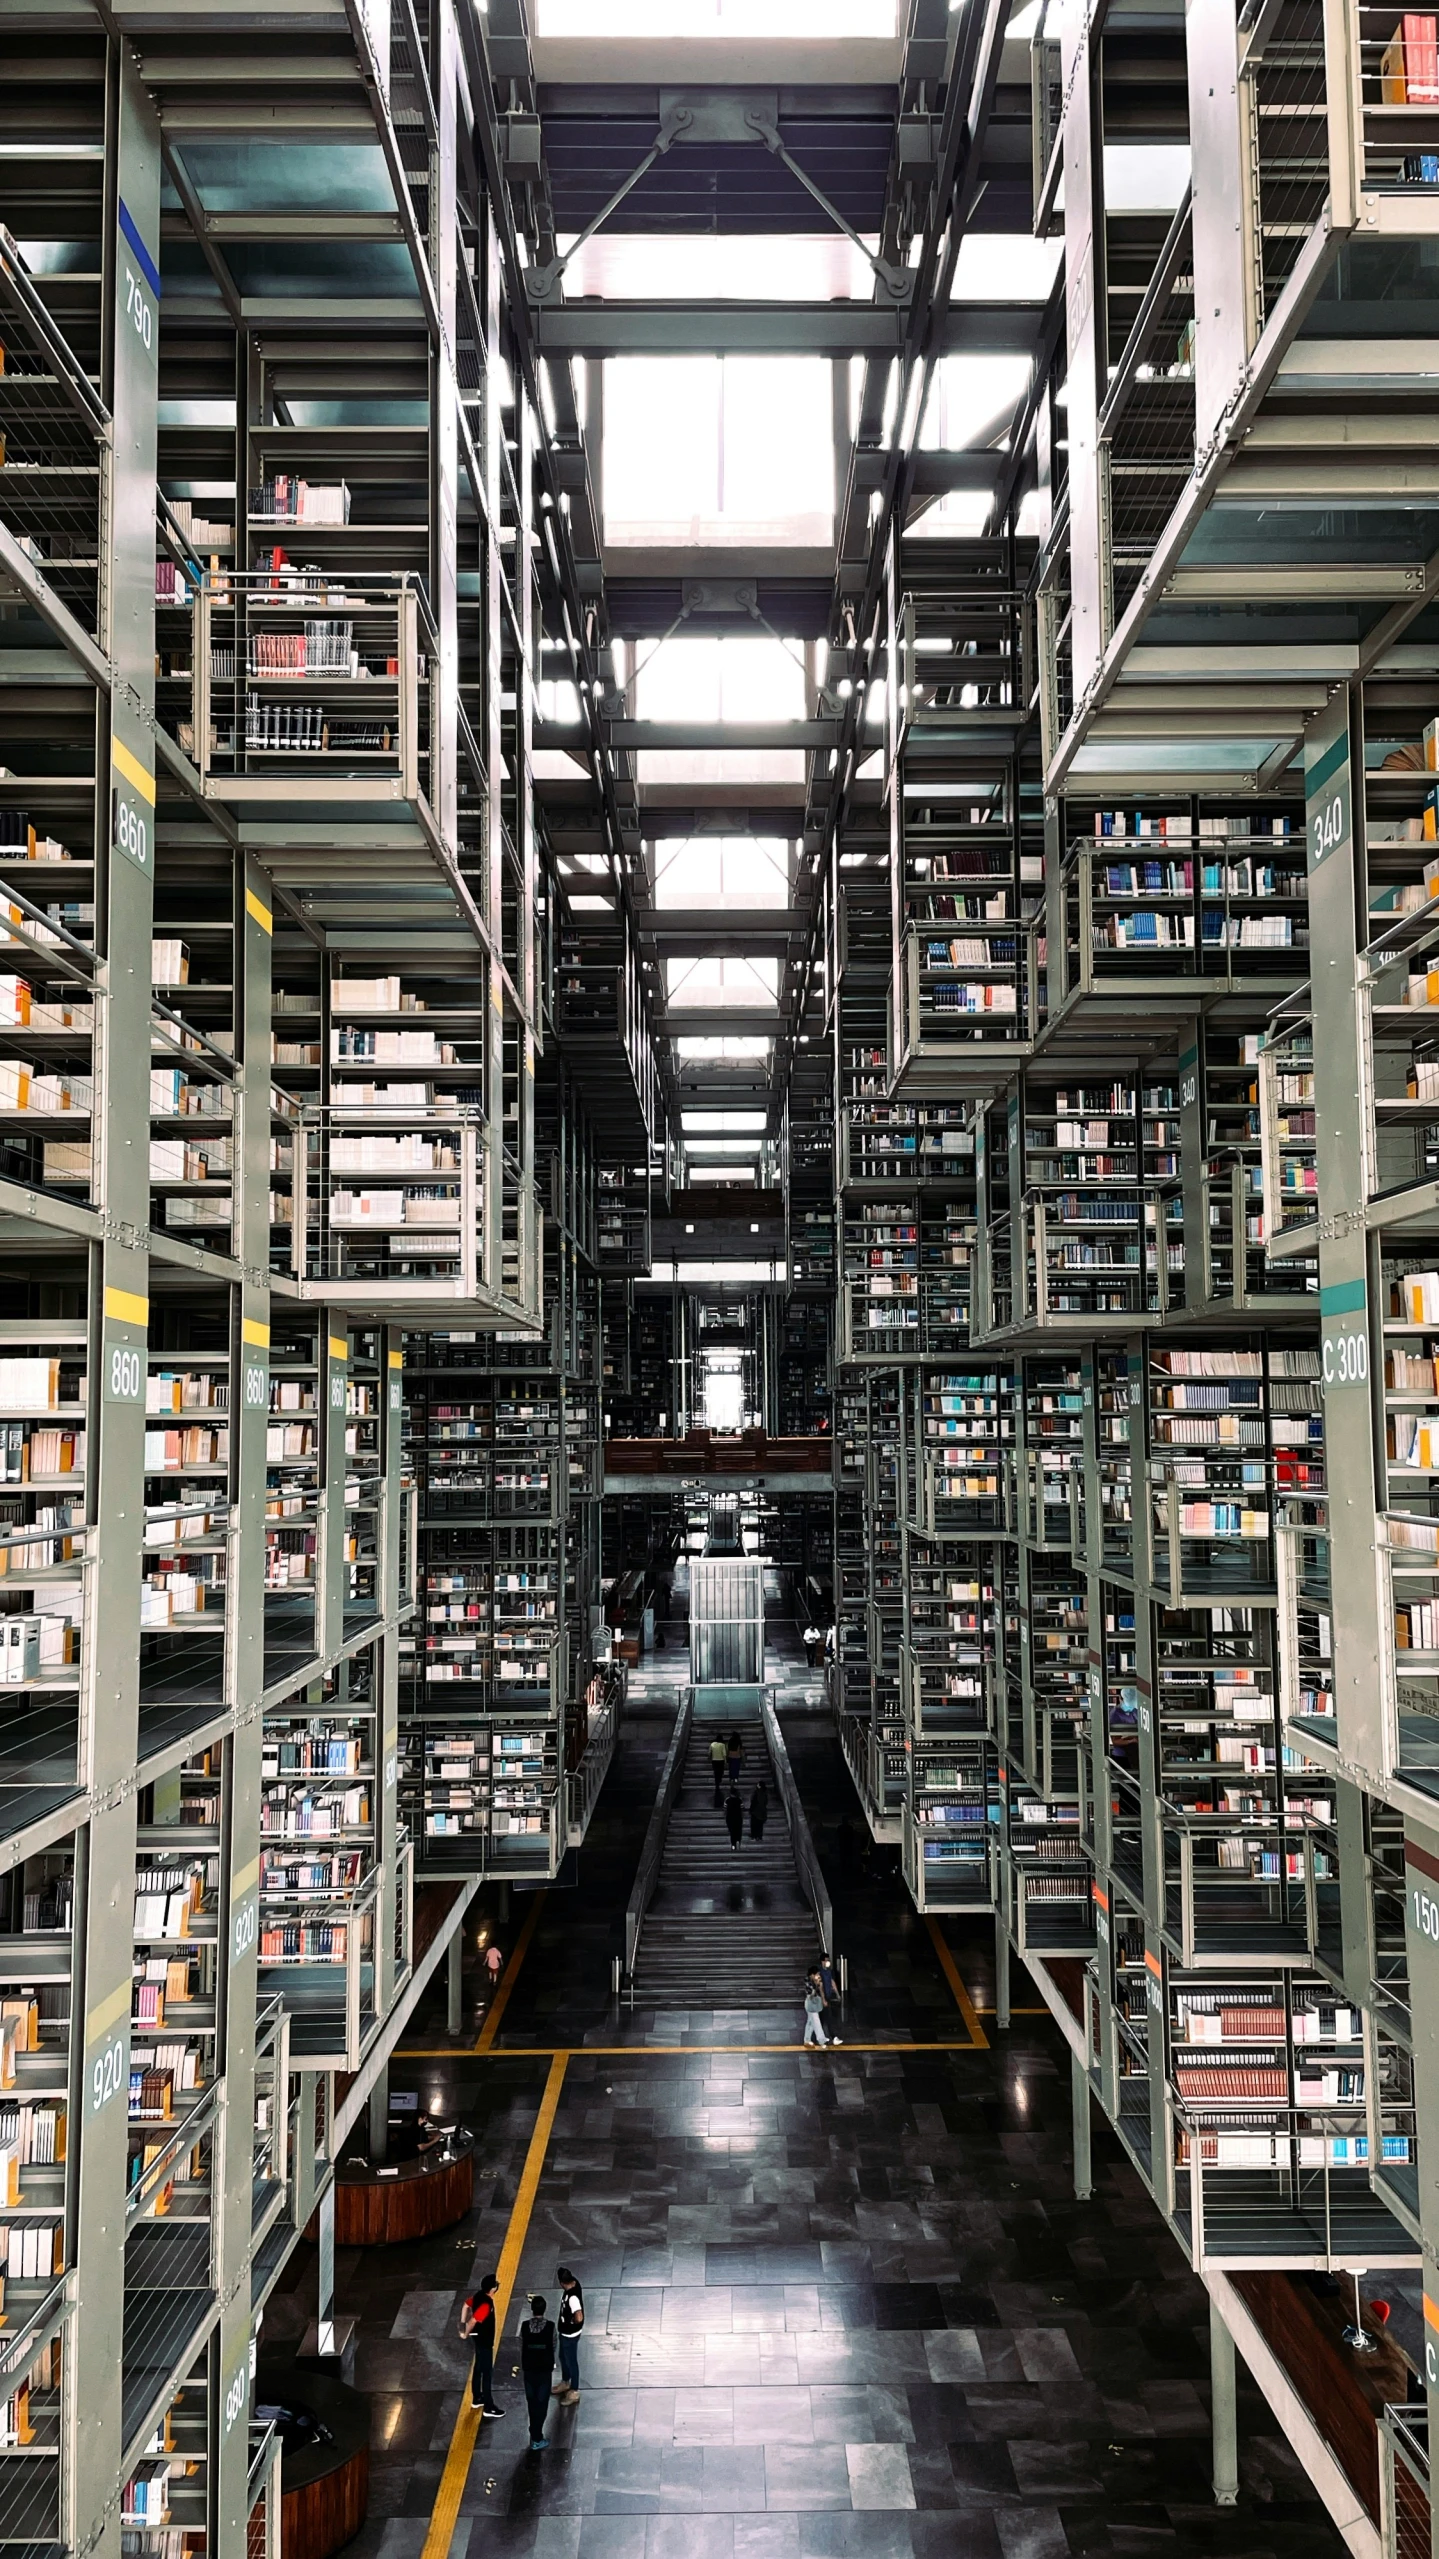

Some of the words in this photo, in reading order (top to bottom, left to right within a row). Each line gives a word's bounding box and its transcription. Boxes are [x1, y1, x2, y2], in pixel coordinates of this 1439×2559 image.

[126, 267, 152, 351] 790
[1070, 272, 1087, 350] 500
[119, 801, 146, 863] 860
[1313, 795, 1343, 861] 340
[1182, 1076, 1195, 1107] 340
[111, 1349, 139, 1398] 860
[1322, 1339, 1335, 1383] C
[1337, 1333, 1367, 1381] 300
[246, 1368, 264, 1404] 860
[331, 1377, 344, 1407] 860
[1130, 1383, 1140, 1405] 300
[1091, 1673, 1100, 1697] 150
[1139, 1706, 1150, 1733] 150
[235, 1905, 253, 1955] 920
[1413, 1891, 1439, 1941] 150
[93, 2039, 122, 2111] 920
[1426, 2341, 1437, 2383] C
[226, 2367, 245, 2433] 980
